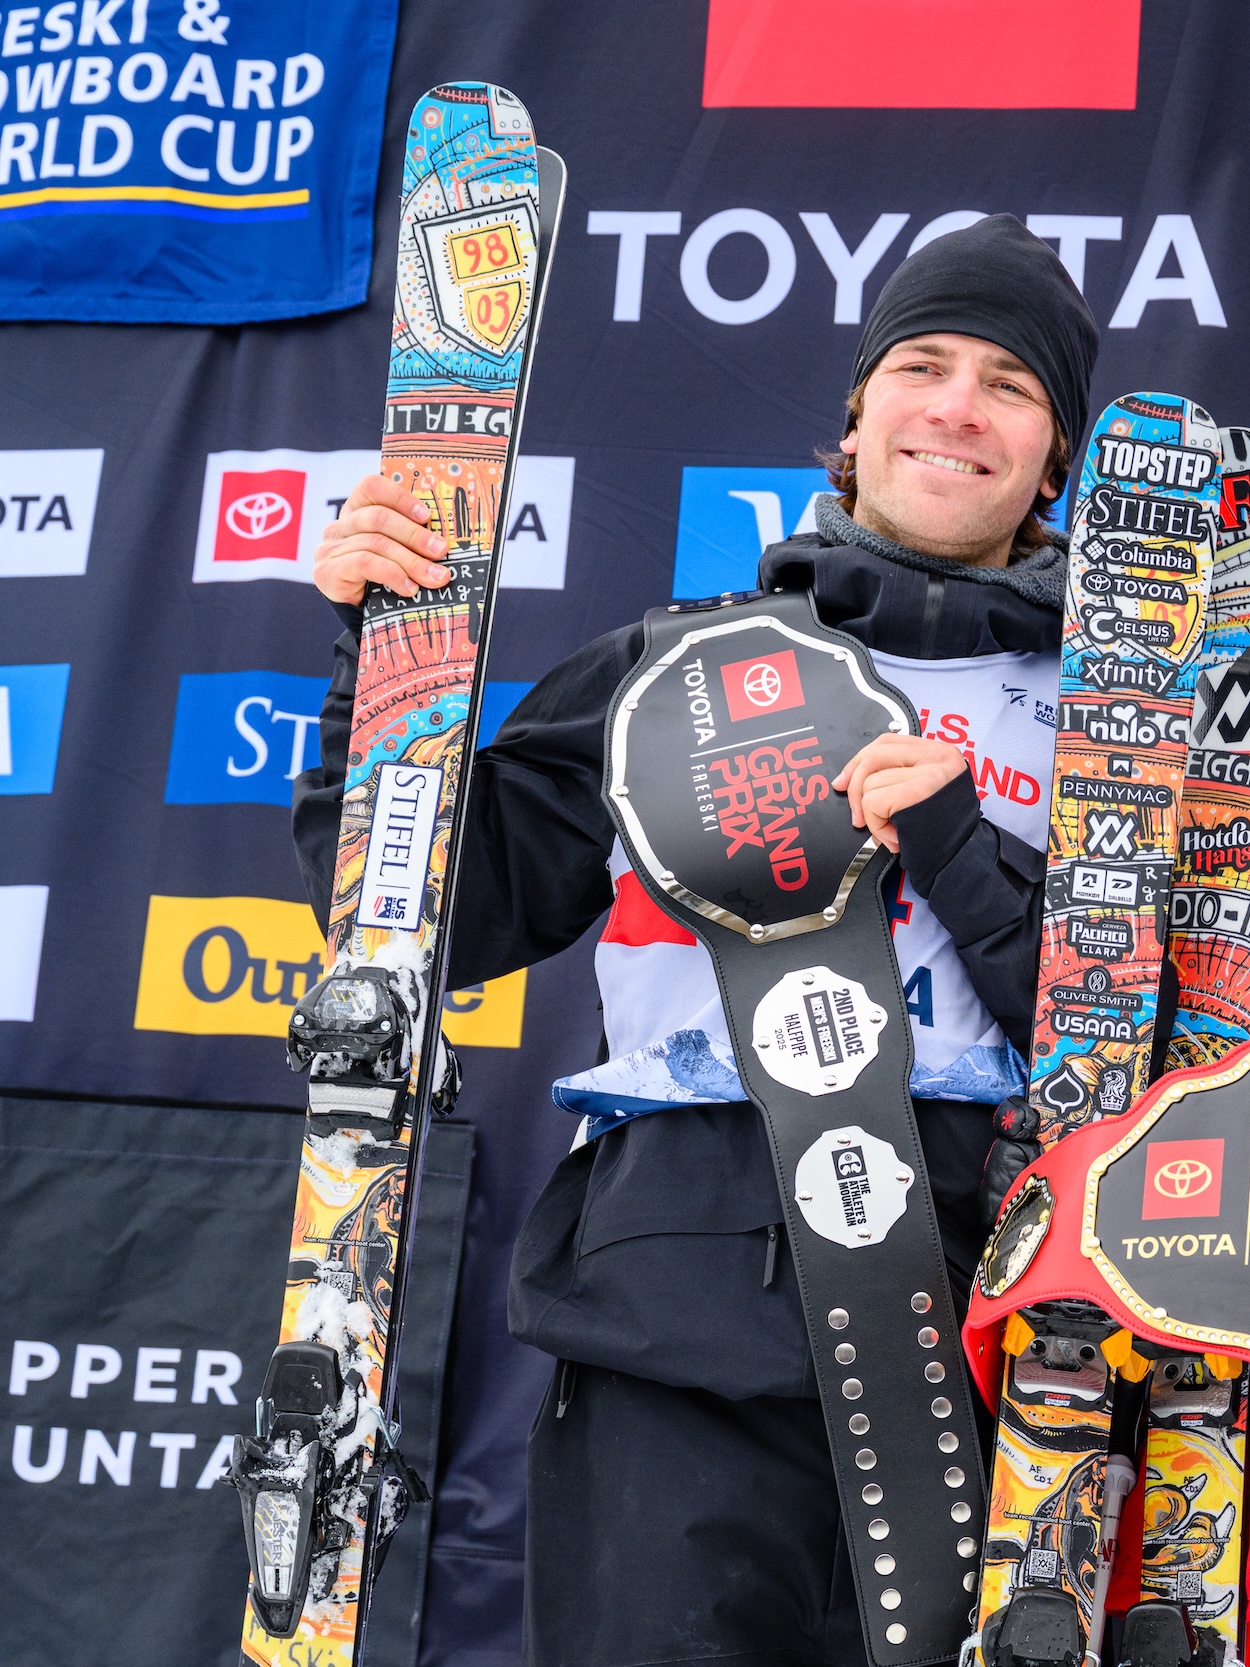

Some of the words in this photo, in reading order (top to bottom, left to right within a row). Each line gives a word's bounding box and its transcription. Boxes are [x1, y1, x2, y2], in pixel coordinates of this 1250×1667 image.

[0, 52, 325, 113] WBOARD
[160, 114, 314, 186] CUP
[463, 232, 508, 273] 98
[587, 208, 1229, 329] TOYTA
[476, 290, 511, 334] 03
[1101, 440, 1212, 489] TOPSTEP
[1091, 489, 1204, 539] STIFEL
[1106, 544, 1193, 571] Columbia
[1114, 578, 1183, 601] TOYOTA
[1115, 621, 1170, 639] CELSIUS
[1085, 658, 1174, 692] xfinity
[683, 658, 716, 746] TOYOTA
[1091, 719, 1155, 745] nulo
[783, 736, 830, 816] U.S.
[1063, 781, 1168, 804] PENNYMAC
[690, 763, 719, 832] FREESKI
[708, 754, 765, 860] PRIX
[378, 771, 427, 877] STIFEL
[746, 745, 809, 892] GRAND
[1071, 921, 1128, 943] PACIFICO
[1102, 922, 1126, 930] CERVEZA
[1082, 944, 1117, 957] CLARA
[832, 988, 854, 1015] 2ND
[1054, 990, 1096, 1003] OLIVER
[1098, 995, 1138, 1008] SMITH
[774, 1028, 787, 1051] 2025
[784, 1013, 808, 1058] HALFPIPE
[816, 1024, 837, 1062] FREESKI
[839, 1015, 865, 1057] PLACE
[1055, 1013, 1132, 1040] USANA
[838, 1182, 857, 1227] MOUNTAIN
[849, 1180, 867, 1225] ATHLETE'S
[859, 1177, 871, 1194] THE
[1122, 1234, 1236, 1260] TOYOTA
[9, 1340, 243, 1405] PPER
[1003, 1512, 1018, 1521] team
[1019, 1514, 1059, 1524] recommended
[1060, 1517, 1073, 1526] boot
[1074, 1519, 1092, 1527] center
